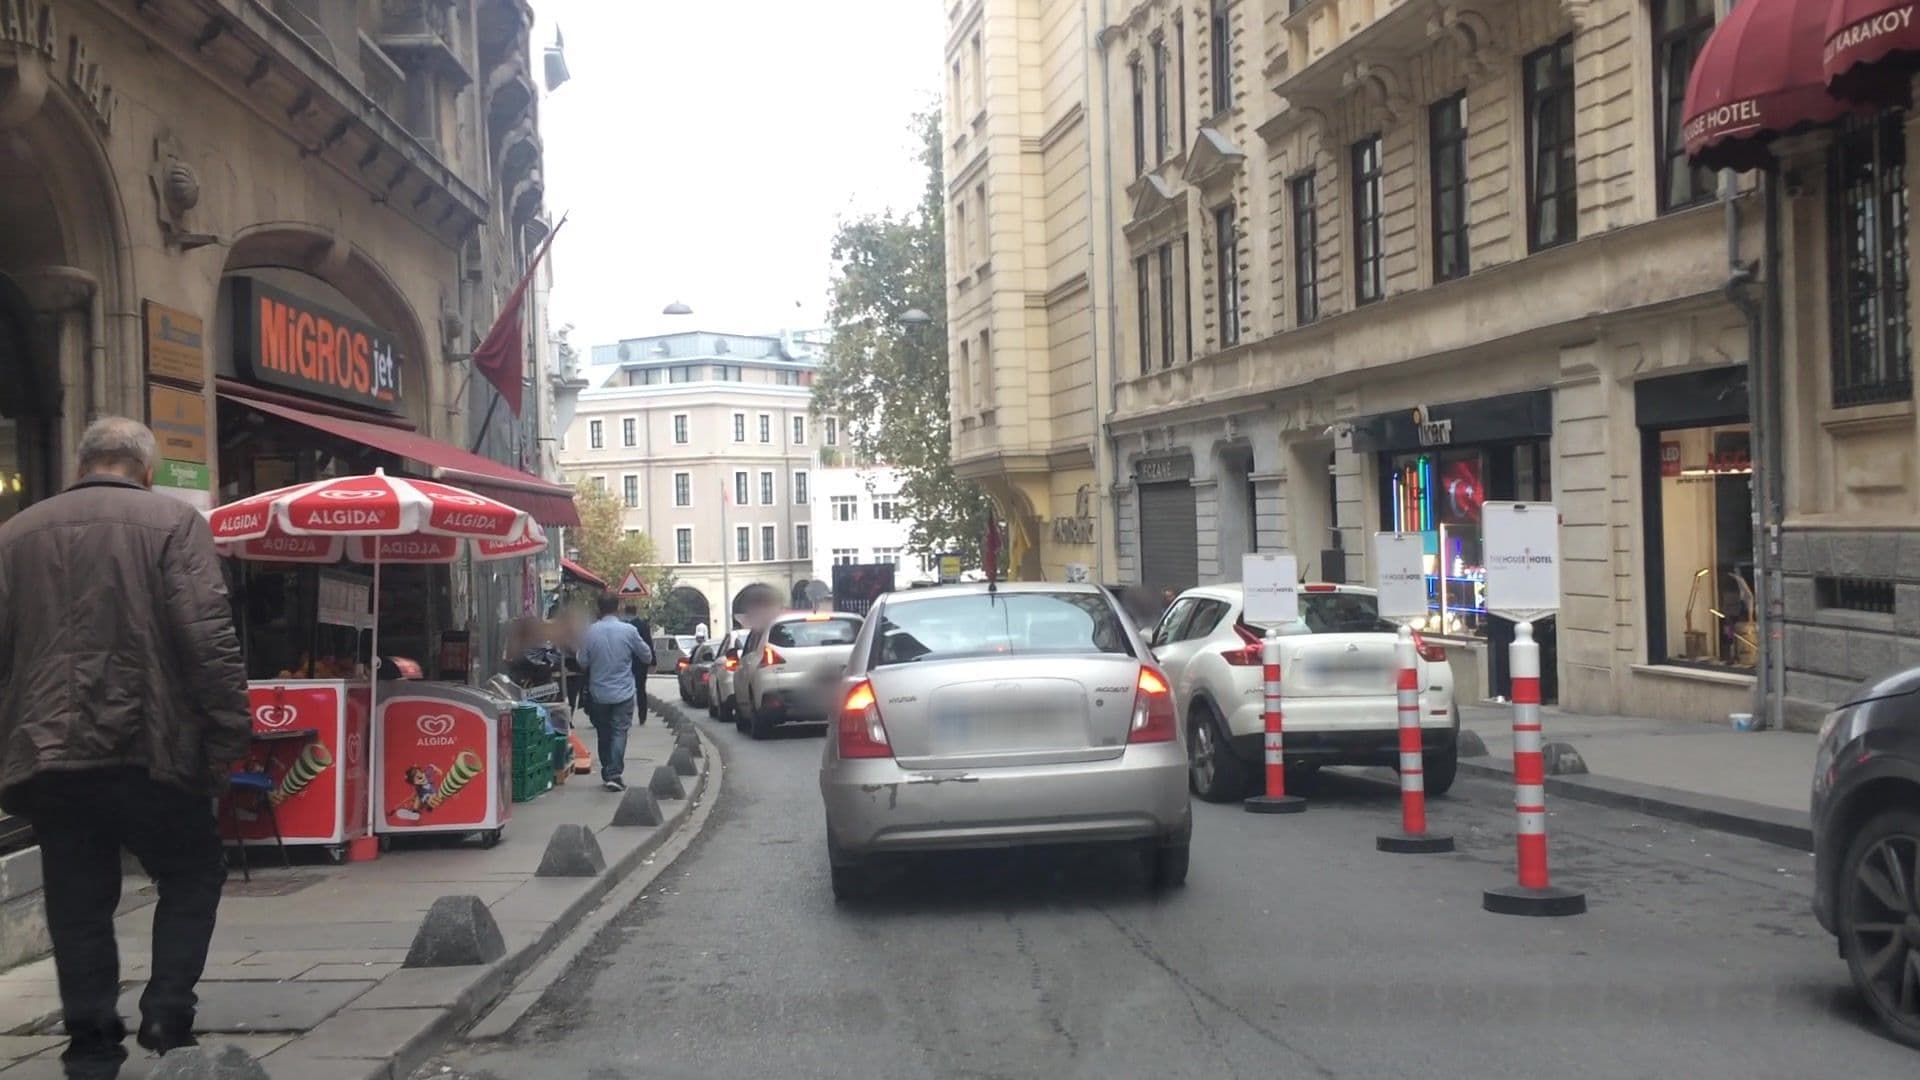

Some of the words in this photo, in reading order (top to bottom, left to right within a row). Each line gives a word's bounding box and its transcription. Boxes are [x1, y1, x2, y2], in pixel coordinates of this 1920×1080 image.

[1707, 99, 1760, 128] HOTEL
[371, 337, 394, 397] jet
[219, 512, 259, 533] ALGIDA
[307, 509, 381, 525] ALGIDA
[443, 511, 497, 529] ALGIDA
[1529, 555, 1553, 564] HOTEL
[416, 736, 457, 746] ALGIDA
